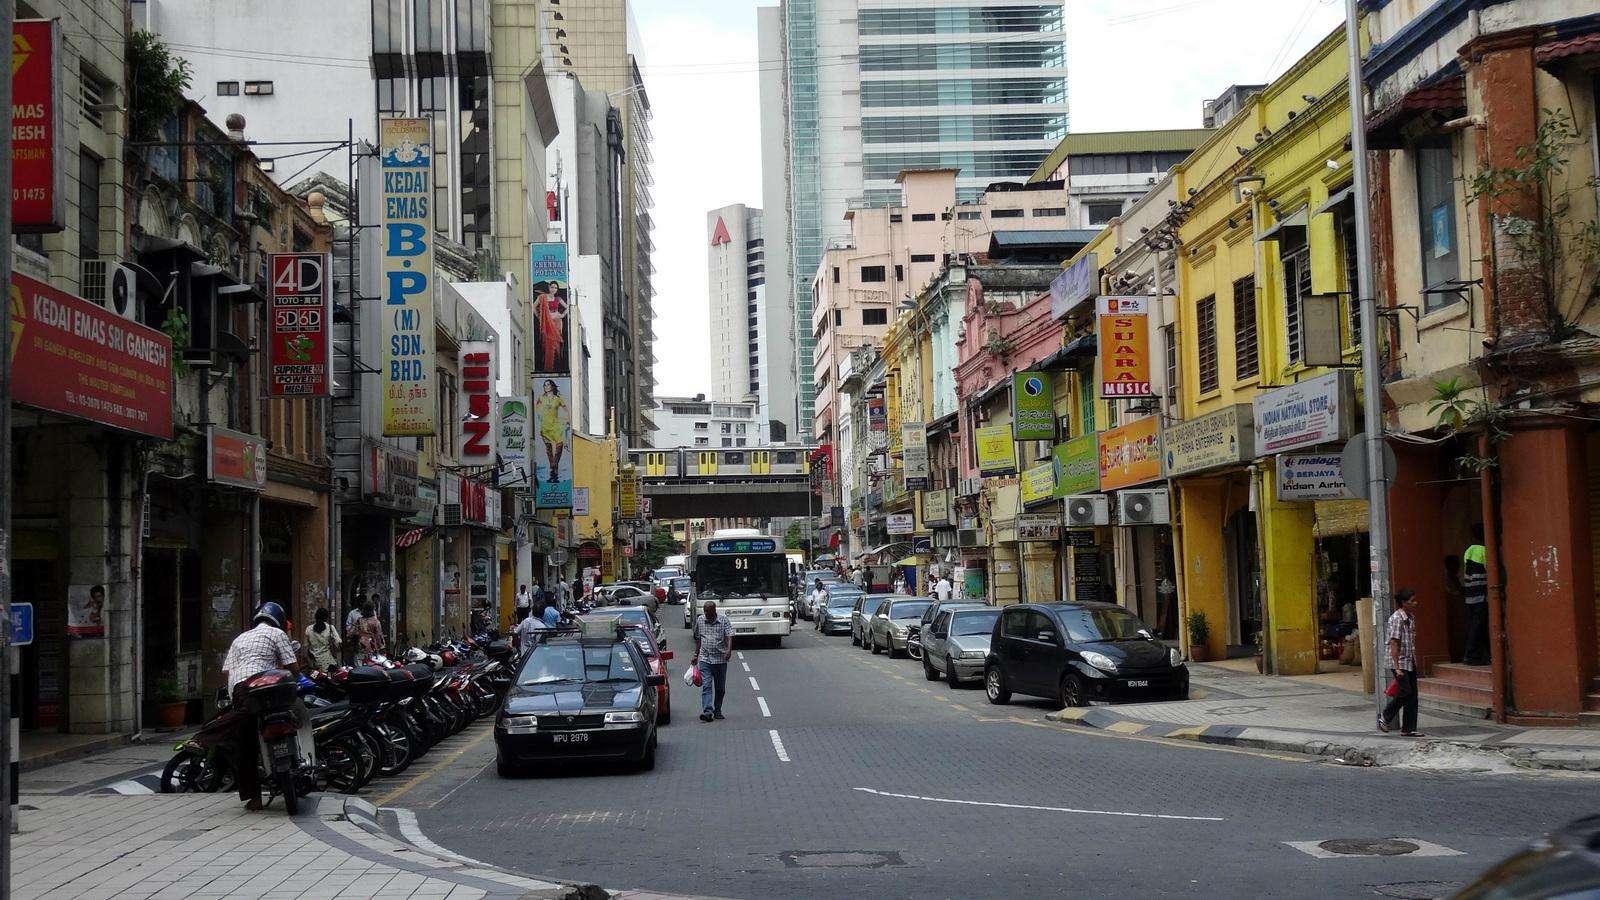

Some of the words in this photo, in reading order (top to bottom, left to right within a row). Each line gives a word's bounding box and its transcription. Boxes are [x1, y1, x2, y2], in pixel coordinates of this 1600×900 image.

[384, 171, 428, 193] KEDAI
[23, 187, 45, 200] 1475
[386, 197, 428, 219] EMAS
[275, 258, 322, 292] 4D
[277, 296, 300, 305] TOTO
[276, 311, 298, 326] 5D
[299, 311, 320, 326] 6D
[394, 309, 420, 331] (M)
[33, 294, 71, 332] KEDAI
[74, 310, 107, 346] EMAS
[108, 324, 124, 352] SRI
[126, 332, 167, 368] GANESH
[391, 334, 426, 356] SDN.
[275, 365, 313, 374] SUPREME
[390, 360, 427, 382] BHD.
[1104, 382, 1149, 395] MUSIC
[1263, 408, 1281, 427] INDIAN
[1280, 400, 1308, 421] NATIONAL
[1308, 394, 1329, 414] STORE
[1296, 470, 1336, 478] BERJAYA
[1282, 482, 1315, 491] Indian
[735, 558, 749, 570] 91
[553, 734, 568, 743] WPU
